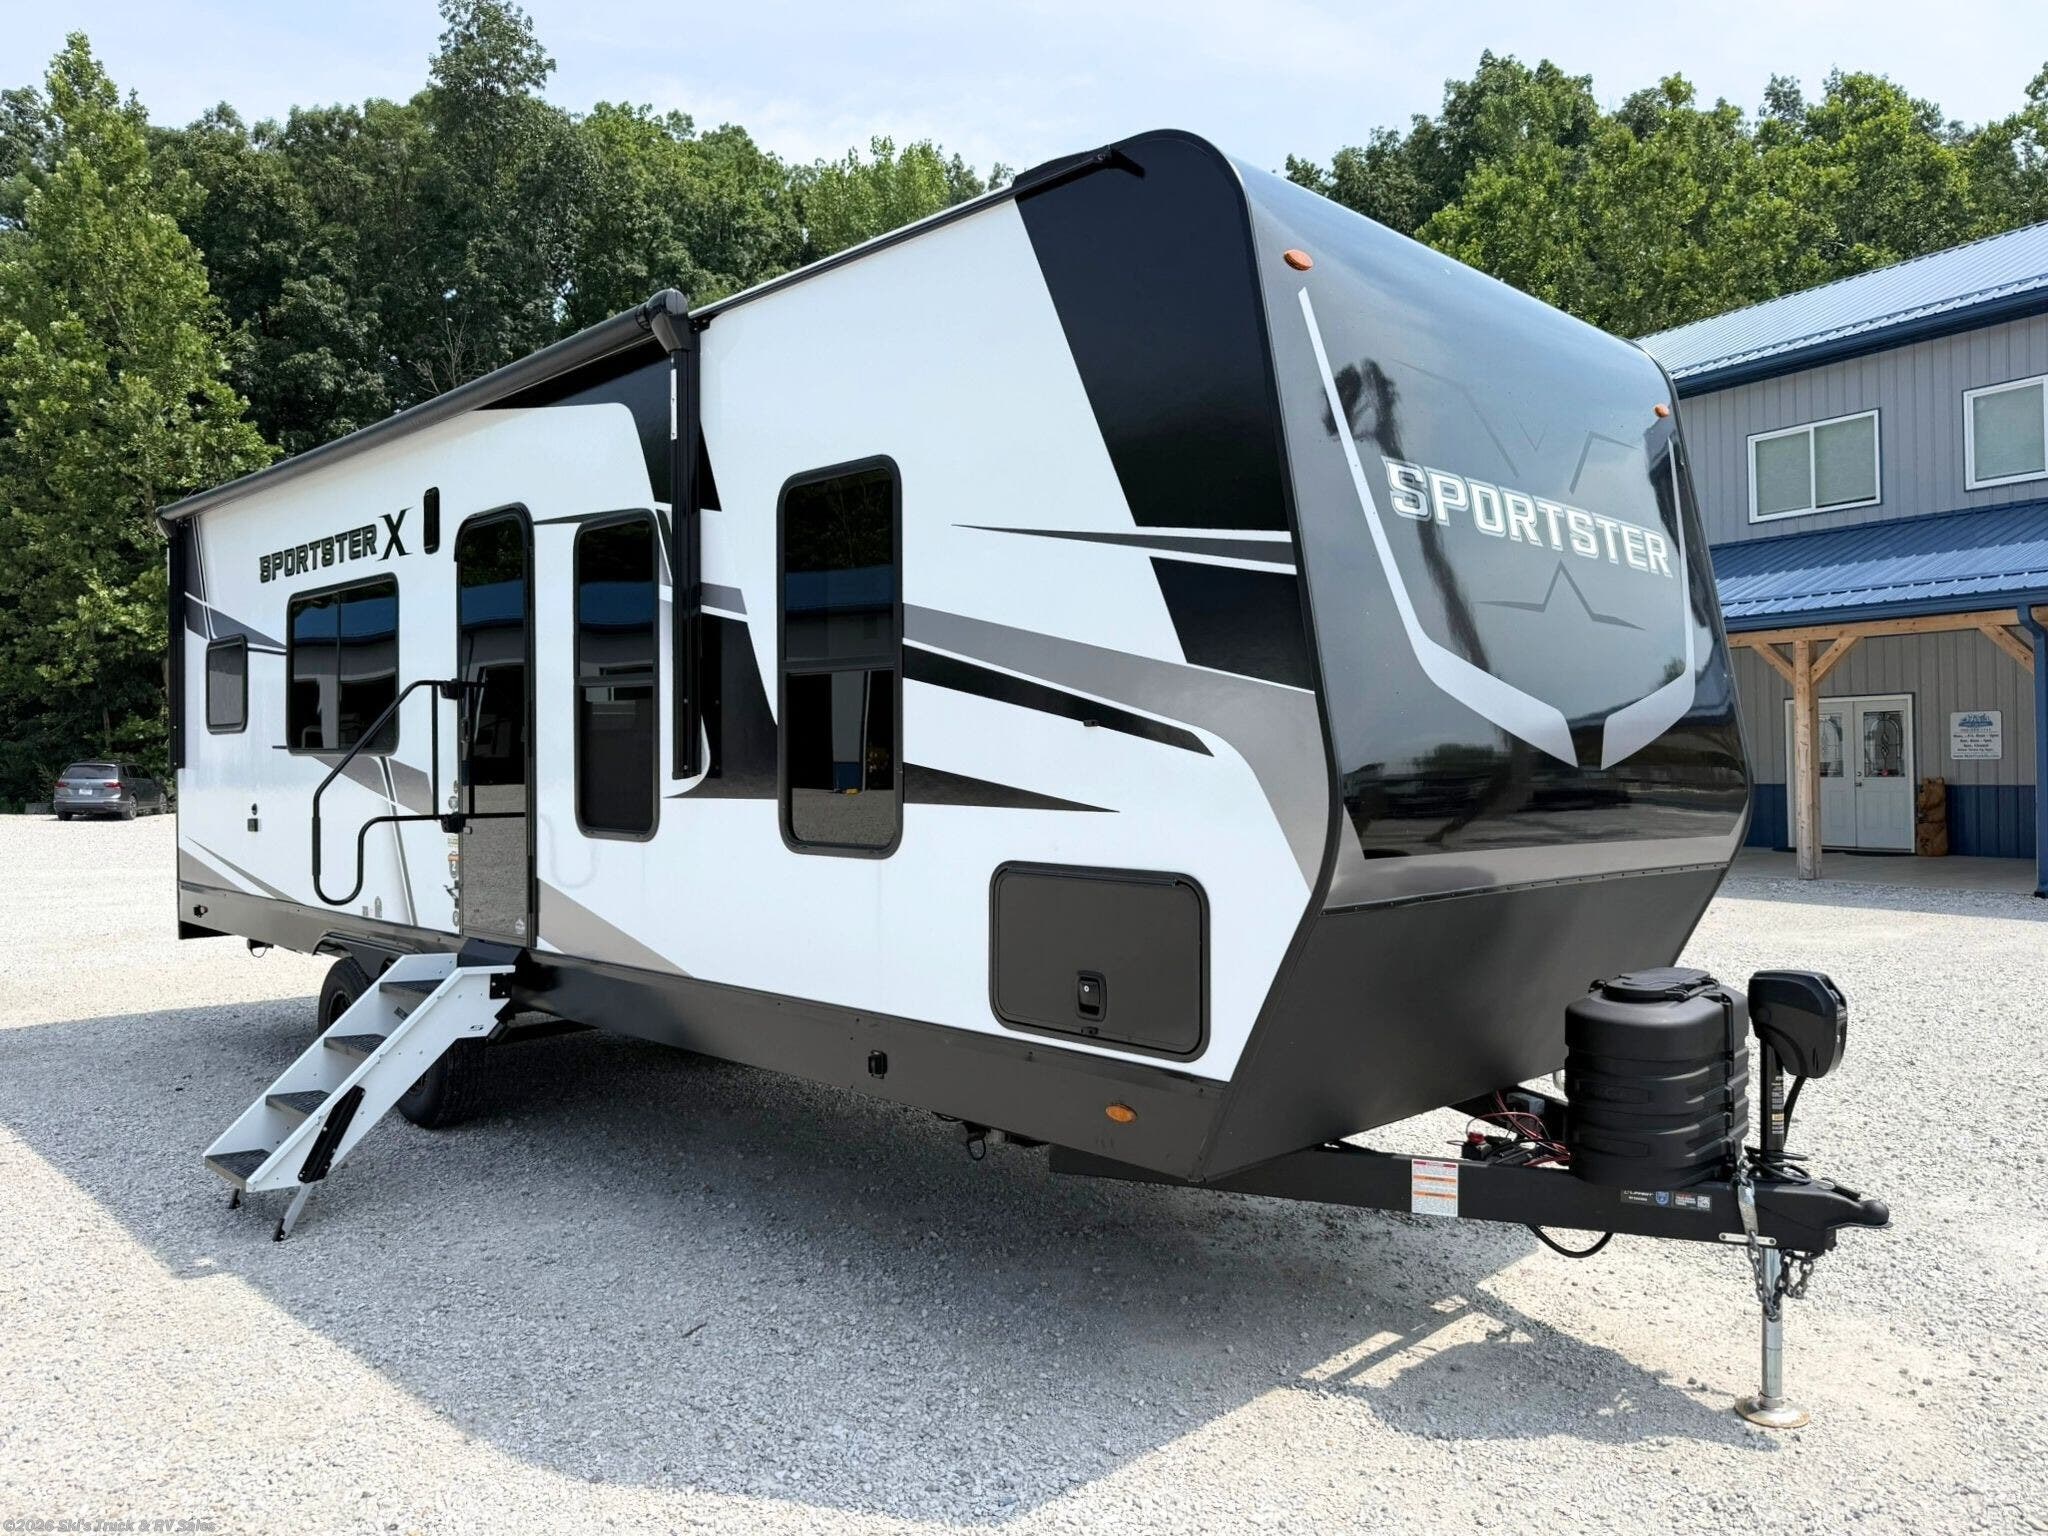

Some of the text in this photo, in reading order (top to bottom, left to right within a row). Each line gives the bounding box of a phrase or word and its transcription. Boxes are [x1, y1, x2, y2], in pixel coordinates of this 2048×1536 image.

[259, 507, 414, 584] SPORTSTER X
[1381, 456, 1673, 578] SPORTSTER
